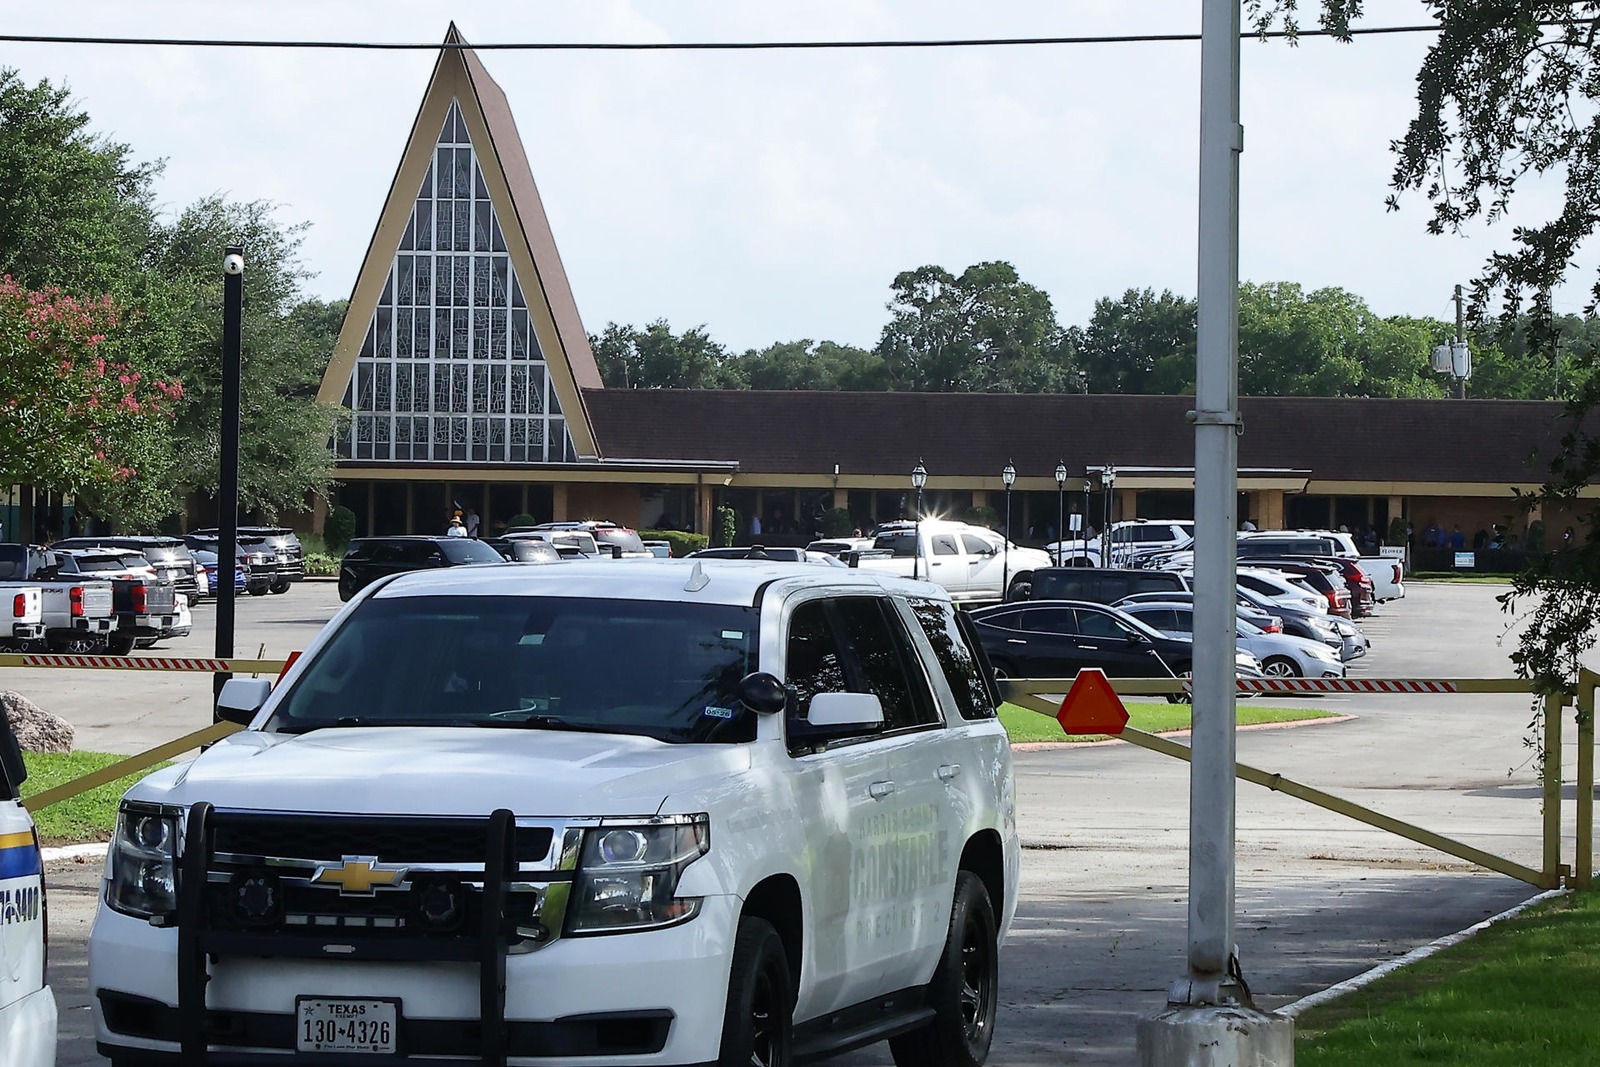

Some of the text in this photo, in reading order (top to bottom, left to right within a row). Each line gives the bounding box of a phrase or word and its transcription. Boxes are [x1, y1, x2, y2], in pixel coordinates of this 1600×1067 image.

[853, 830, 949, 900] CONSTABLE
[933, 901, 941, 923] 2
[328, 1004, 366, 1015] TEXAS
